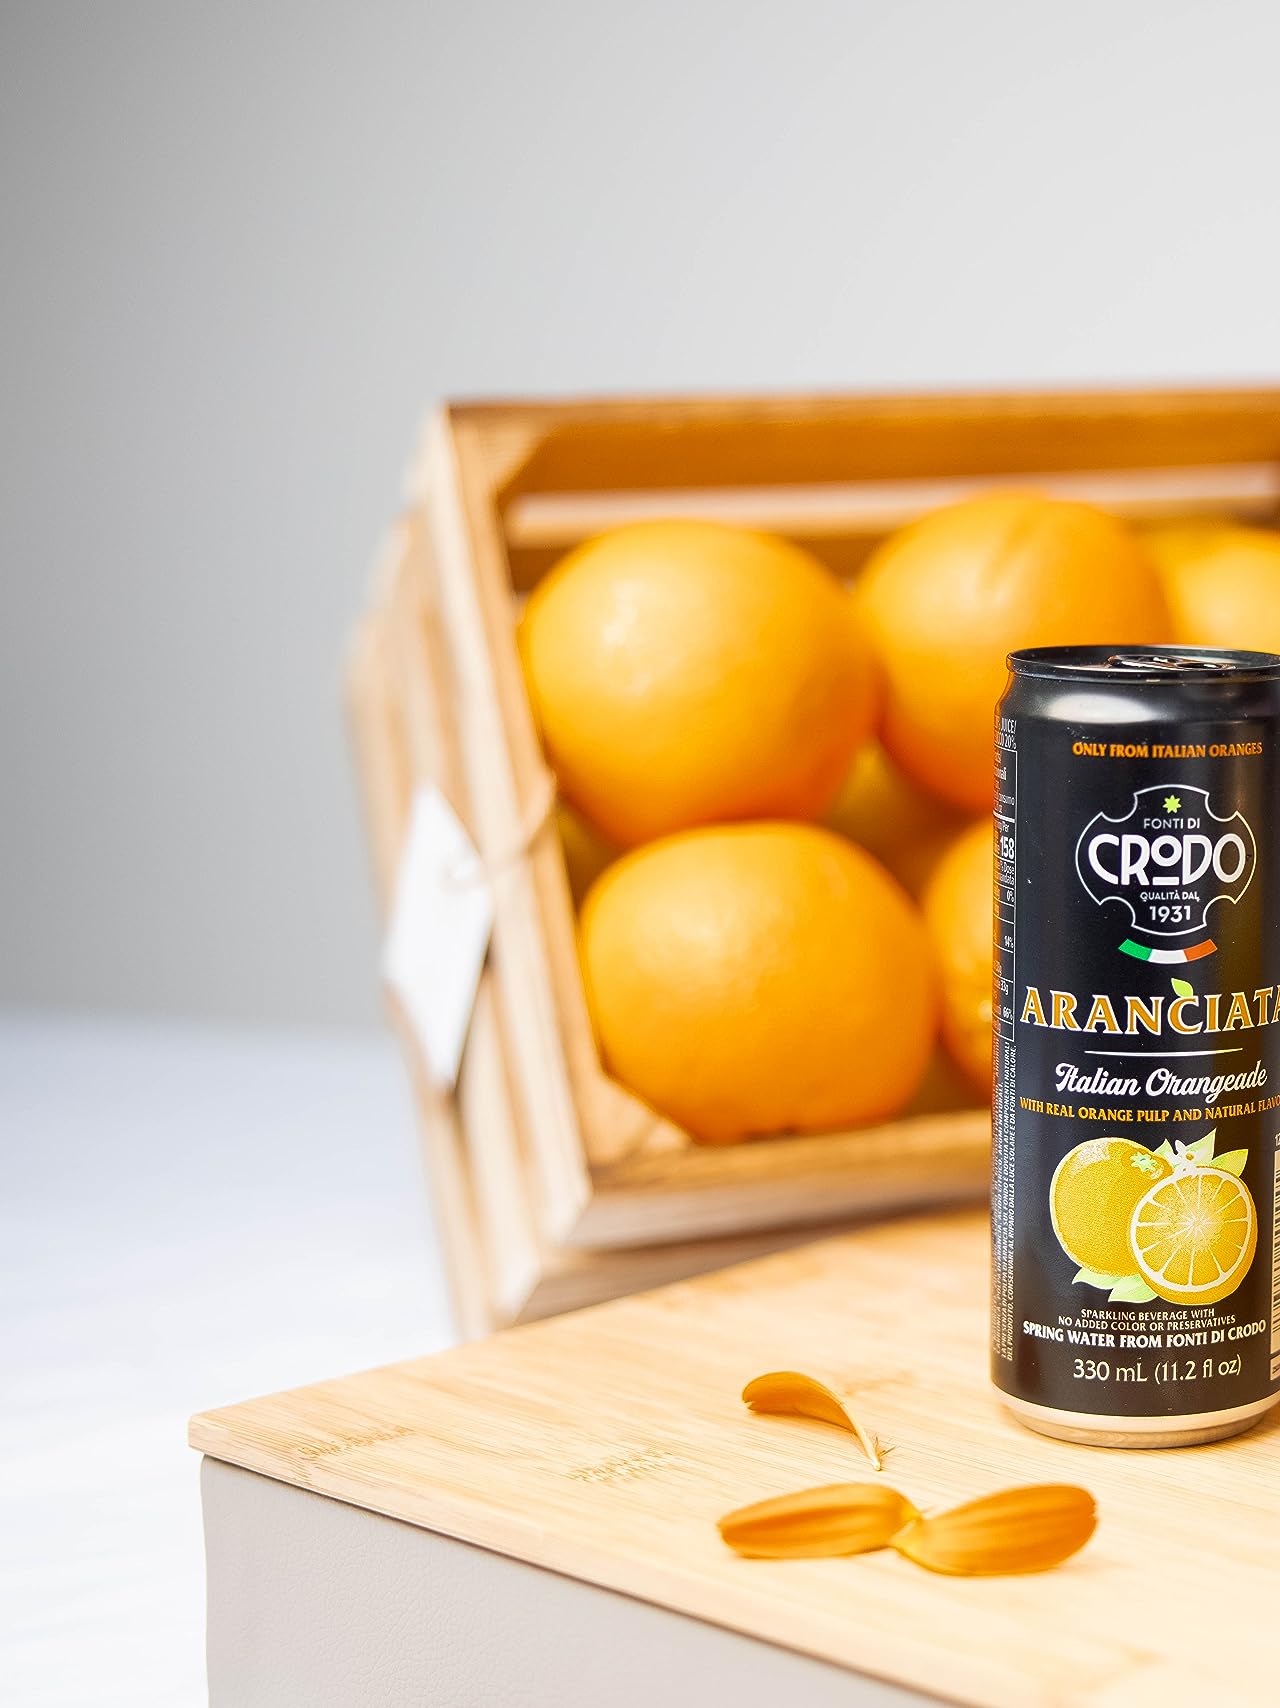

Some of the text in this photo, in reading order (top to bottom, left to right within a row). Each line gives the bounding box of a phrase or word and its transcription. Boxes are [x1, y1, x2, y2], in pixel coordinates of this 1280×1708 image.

[1072, 742, 1263, 759] ONLY FROM ITALIAN ORANGES
[1143, 817, 1201, 829] FONTI DI
[1000, 835, 1015, 860] 158
[1088, 833, 1246, 886] CRODO
[1140, 889, 1200, 902] QUALITÀ DAL
[1150, 905, 1192, 923] 1931
[1055, 1060, 1267, 1104] Italian Orangeade
[1020, 1096, 1044, 1114] WITH
[1046, 1102, 1075, 1118] REAL
[1078, 1106, 1134, 1122] ORANGE
[1137, 1109, 1170, 1123] PULP
[1173, 1109, 1202, 1122] AND
[1205, 1103, 1257, 1120] NATURAL
[1058, 1315, 1236, 1332] NO ADDED COLOR OR PRESERVATIVES
[1081, 1307, 1215, 1322] SPARKLING BEVERAGE WITH
[1023, 1319, 1267, 1348] SPRING WATER FROM FONTI DI CRODO
[1073, 1354, 1243, 1384] 330 mL (11.2 fl oz)
